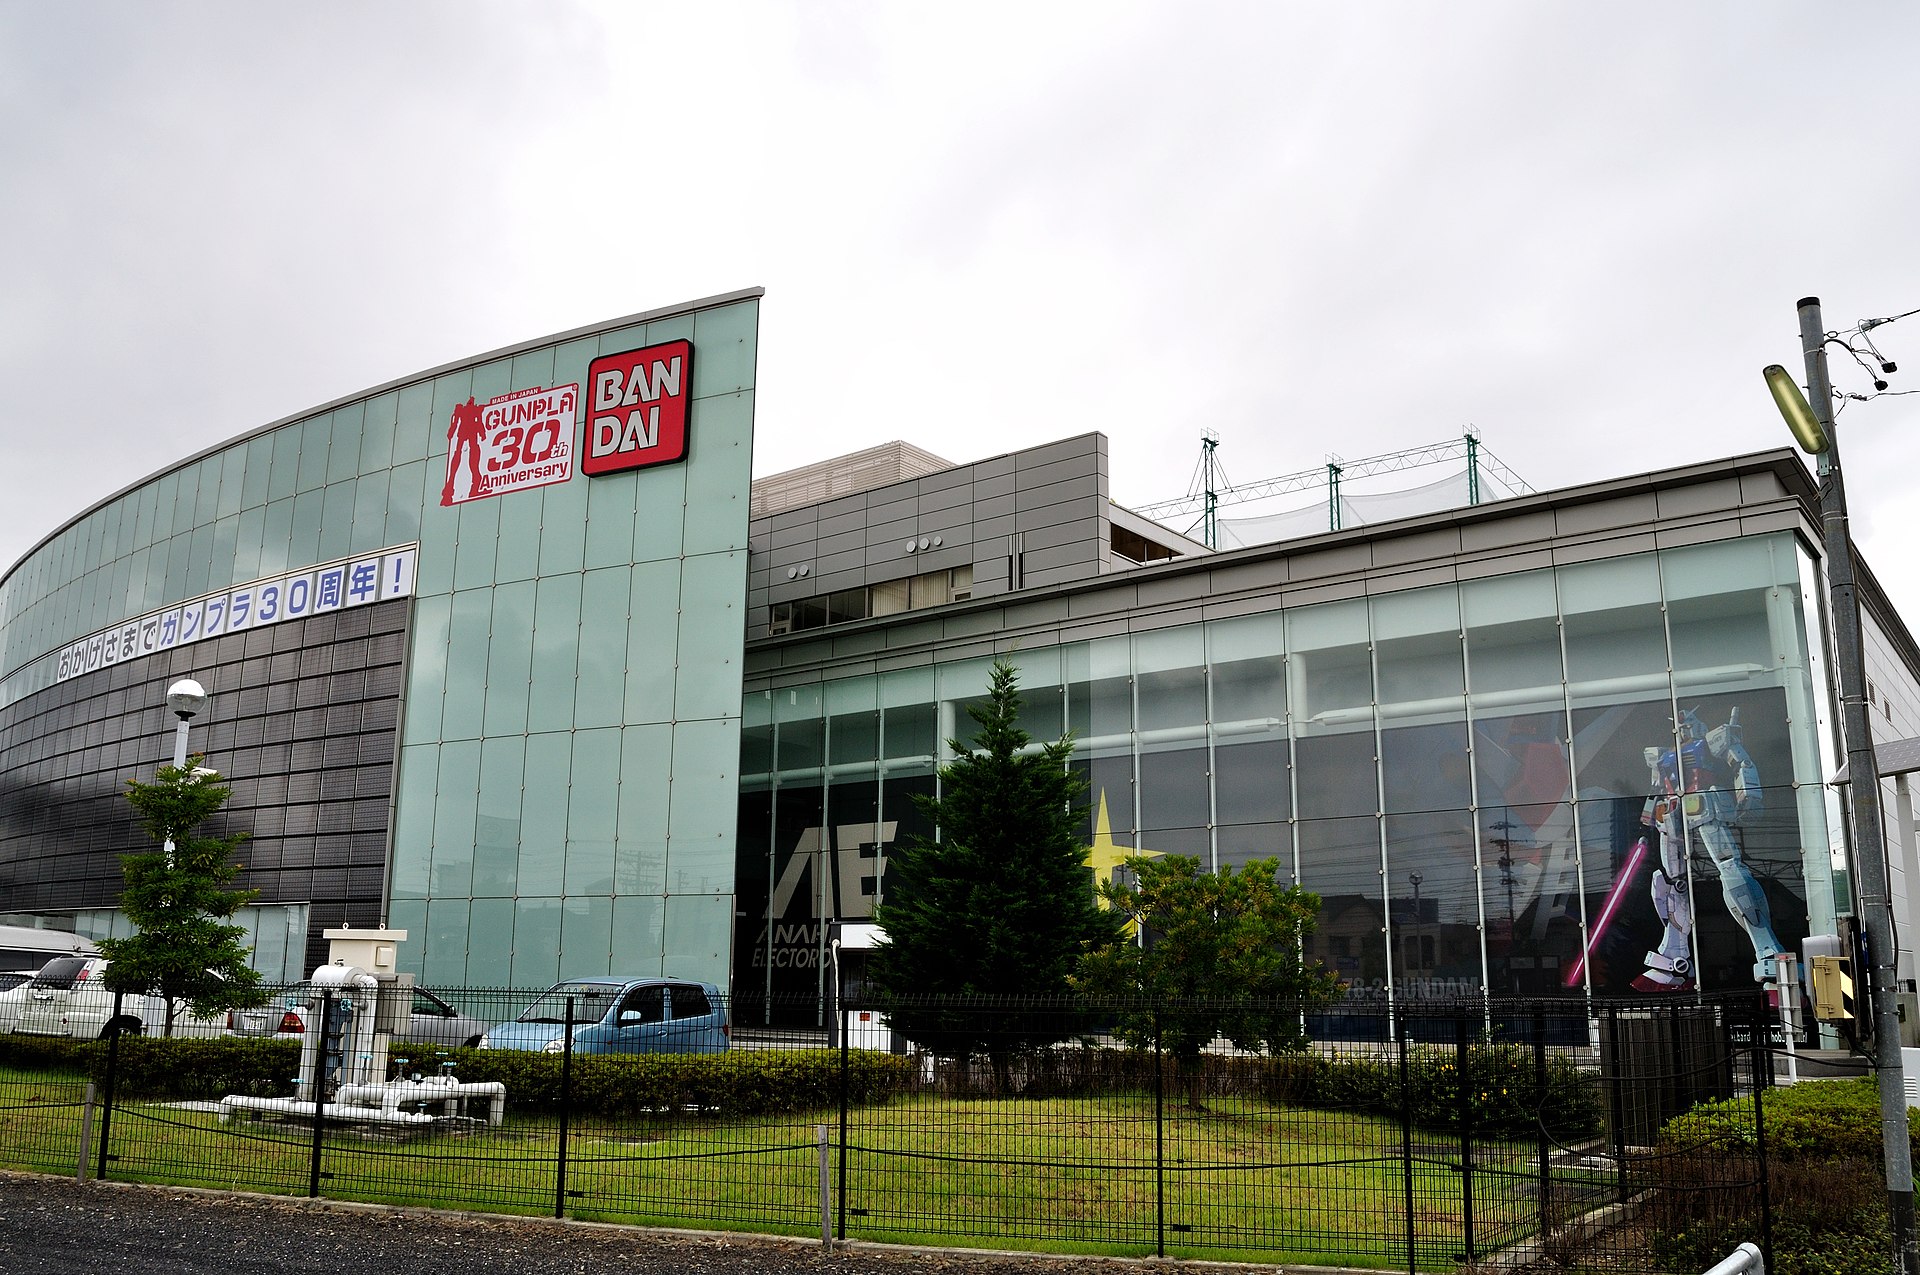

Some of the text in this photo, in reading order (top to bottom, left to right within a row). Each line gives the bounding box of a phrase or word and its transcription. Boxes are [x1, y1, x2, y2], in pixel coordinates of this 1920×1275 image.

[491, 395, 509, 405] MADE
[518, 388, 538, 398] JAPAN
[595, 356, 682, 412] BAN
[485, 391, 574, 431] GUNPLA
[591, 406, 660, 458] DAI
[479, 461, 569, 492] Anniversary
[756, 923, 831, 944] ANAH
